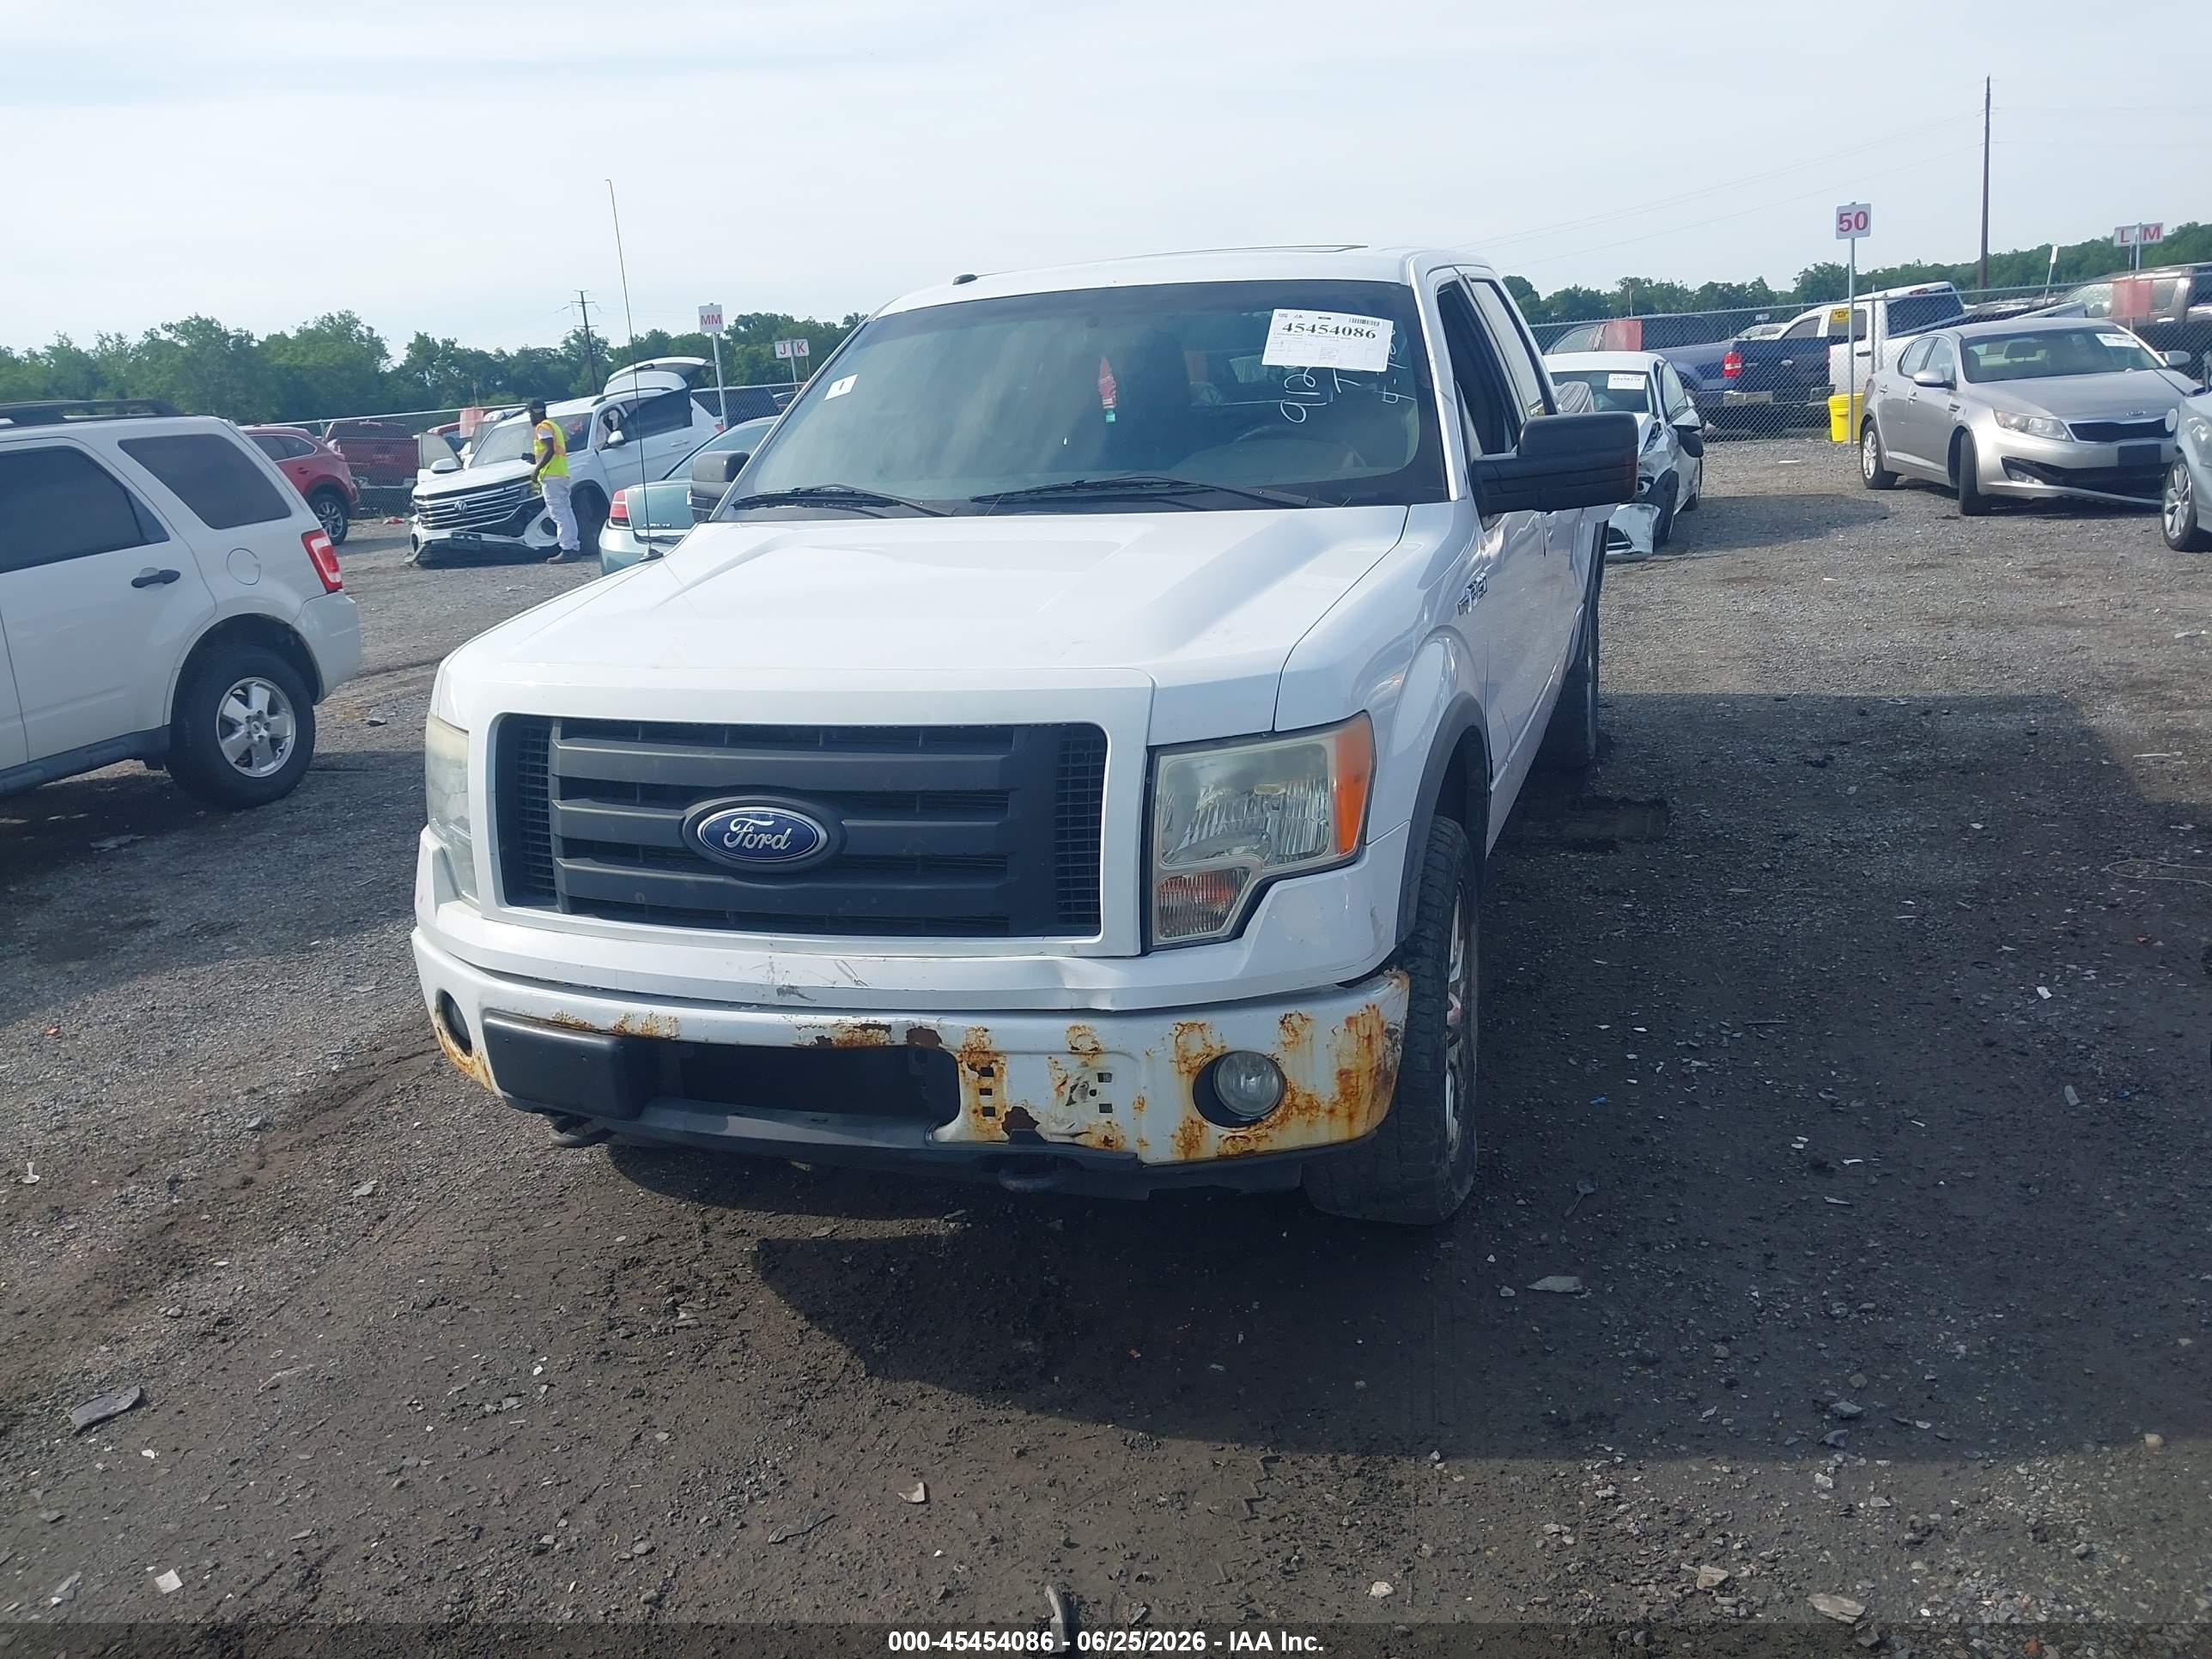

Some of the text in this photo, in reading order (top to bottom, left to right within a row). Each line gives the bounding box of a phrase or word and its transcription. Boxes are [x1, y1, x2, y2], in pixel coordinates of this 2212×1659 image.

[1838, 210, 1869, 232] 50
[2120, 226, 2160, 243] L M
[701, 314, 722, 325] MM
[1282, 322, 1376, 339] 45454086
[780, 342, 805, 355] J K
[723, 817, 793, 850] Ford
